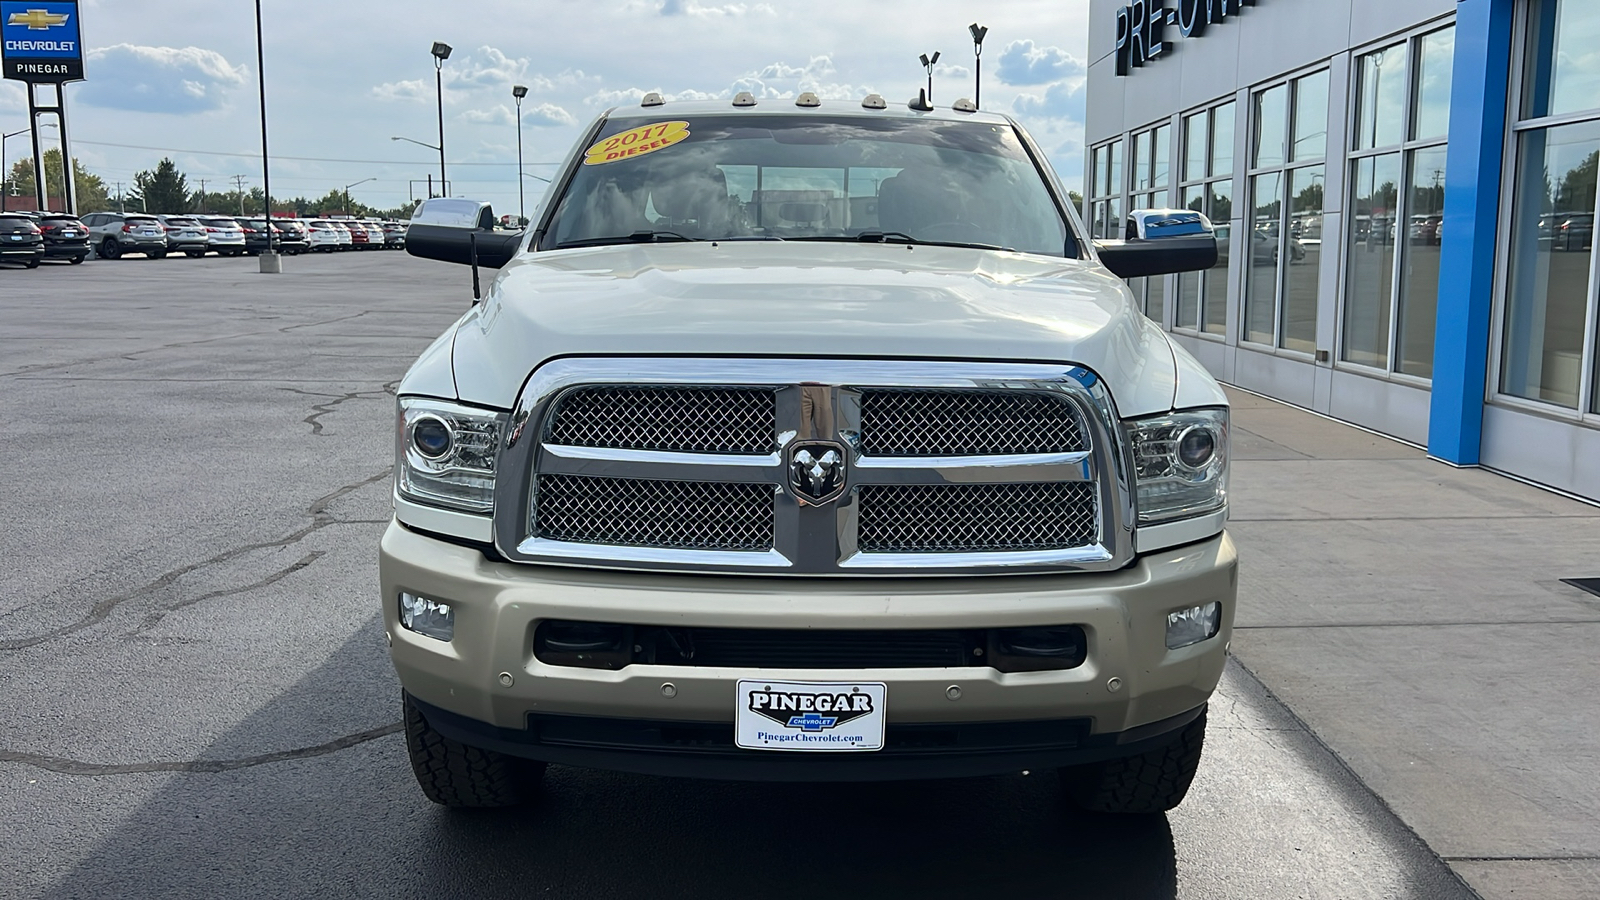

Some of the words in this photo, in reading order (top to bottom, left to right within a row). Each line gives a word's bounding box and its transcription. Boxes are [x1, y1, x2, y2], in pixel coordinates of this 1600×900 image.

[5, 40, 75, 51] CHEVROLET
[1115, 0, 1250, 77] PRE-O
[16, 63, 69, 74] PINEGAR
[603, 123, 670, 153] 2017
[605, 137, 671, 160] DIESEL
[751, 692, 872, 712] PINEGAR
[757, 731, 863, 743] PinegarChevrolet.com
